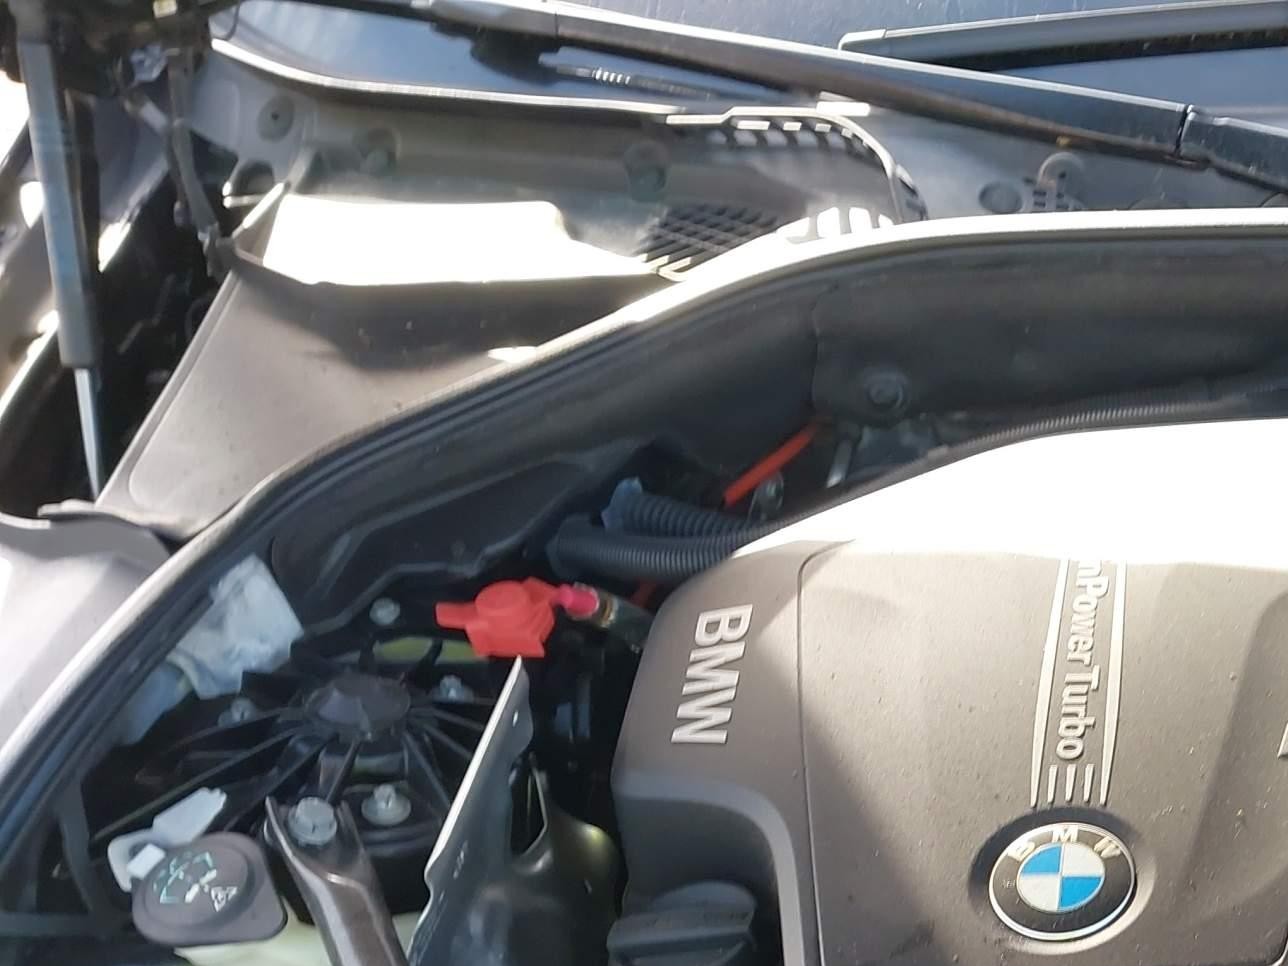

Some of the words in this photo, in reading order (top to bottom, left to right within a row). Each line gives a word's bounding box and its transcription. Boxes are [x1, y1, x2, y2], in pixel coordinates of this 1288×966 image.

[1066, 559, 1110, 667] nPower
[670, 604, 753, 744] BMW
[1056, 665, 1101, 761] Turbo
[1007, 824, 1121, 862] BMW
